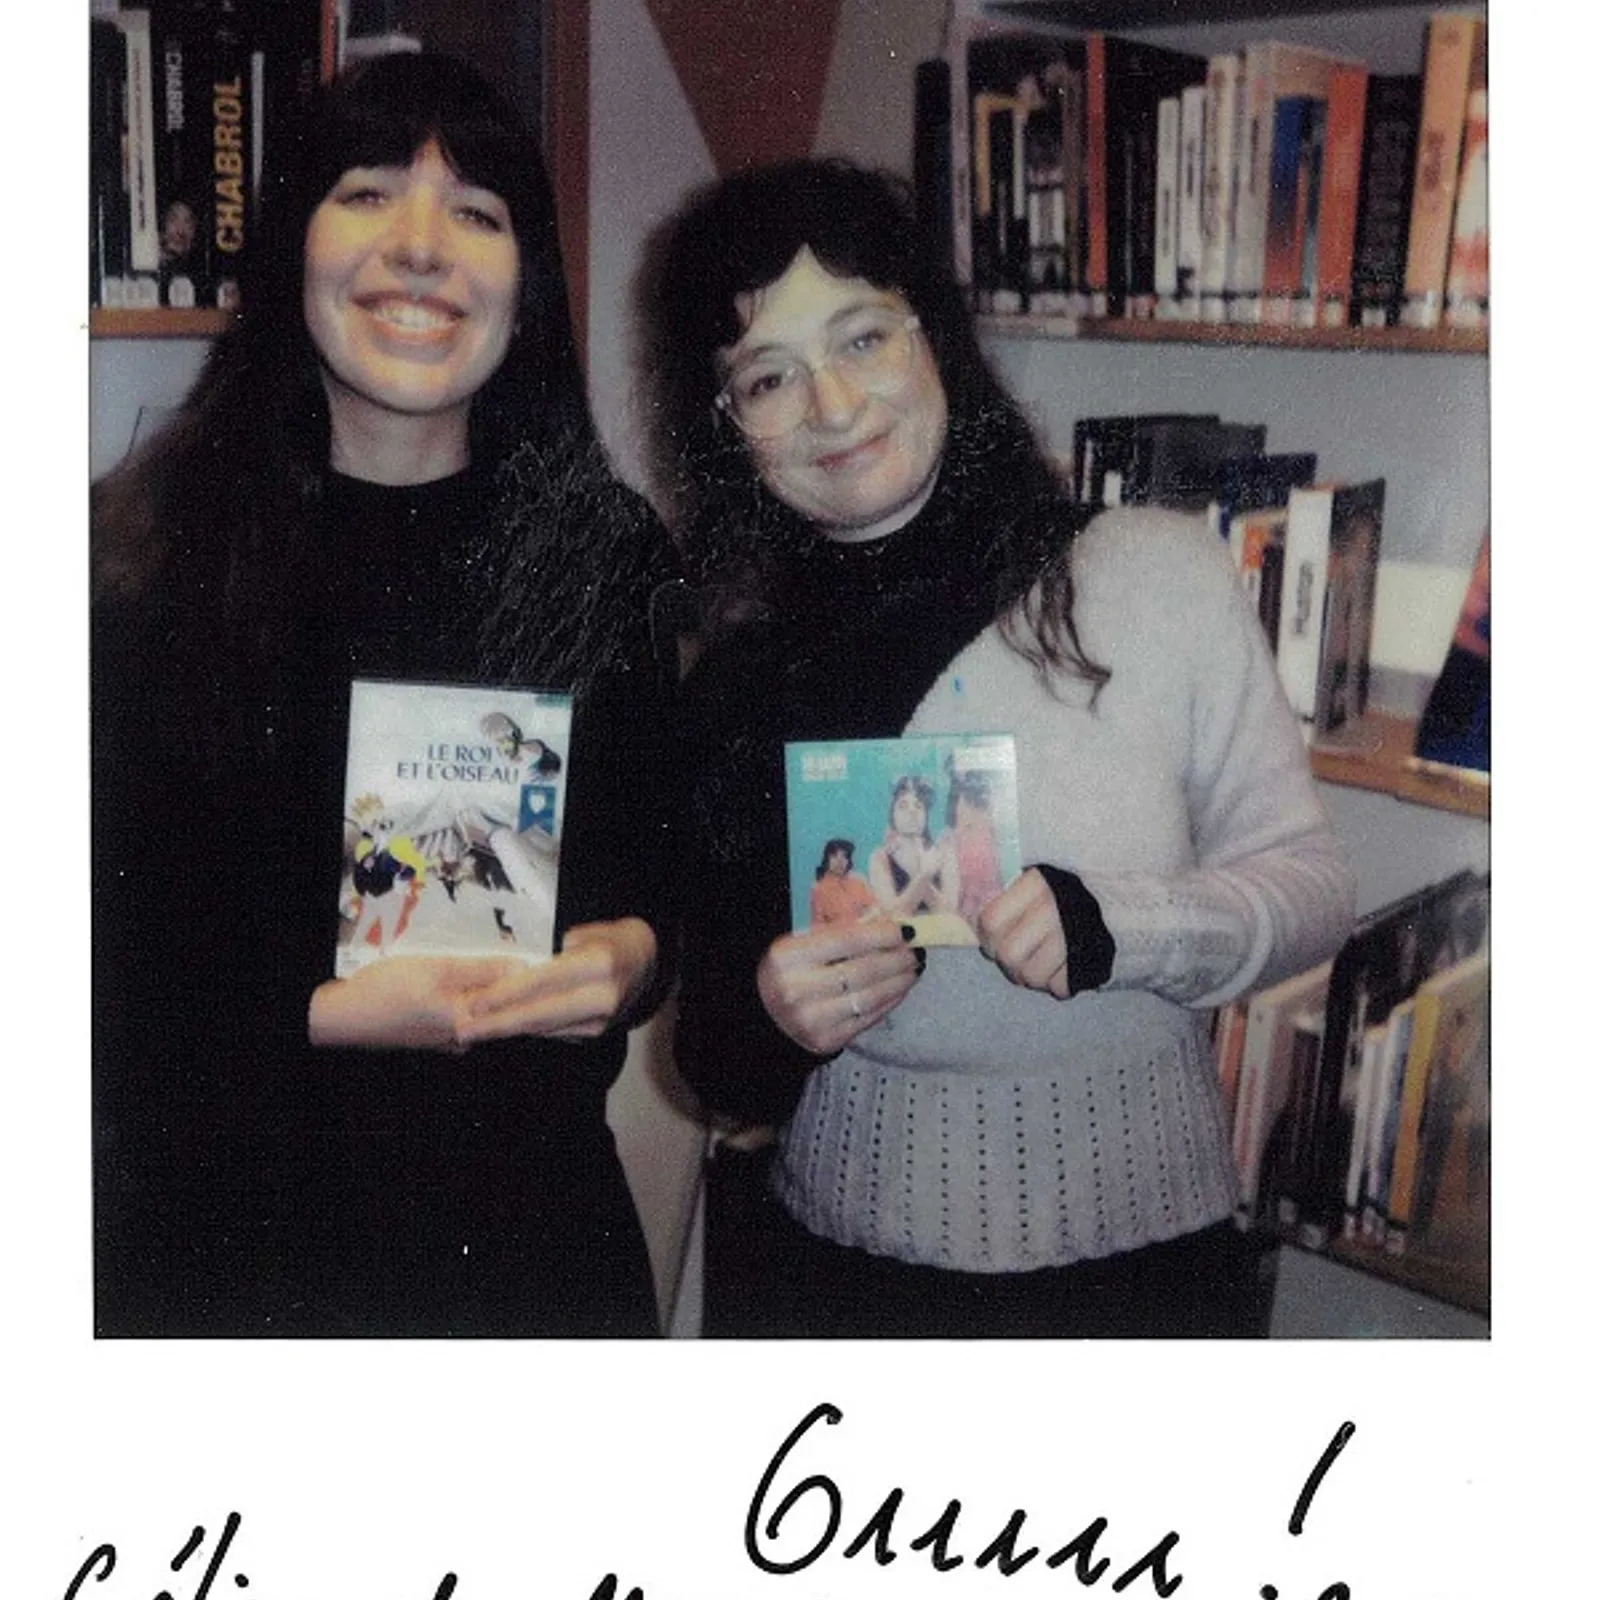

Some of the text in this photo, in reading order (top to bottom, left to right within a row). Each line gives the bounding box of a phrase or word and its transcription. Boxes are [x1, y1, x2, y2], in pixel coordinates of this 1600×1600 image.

[213, 75, 244, 251] CHABROL
[427, 743, 492, 763] LE ROI
[396, 761, 519, 786] ET L'OISEAU
